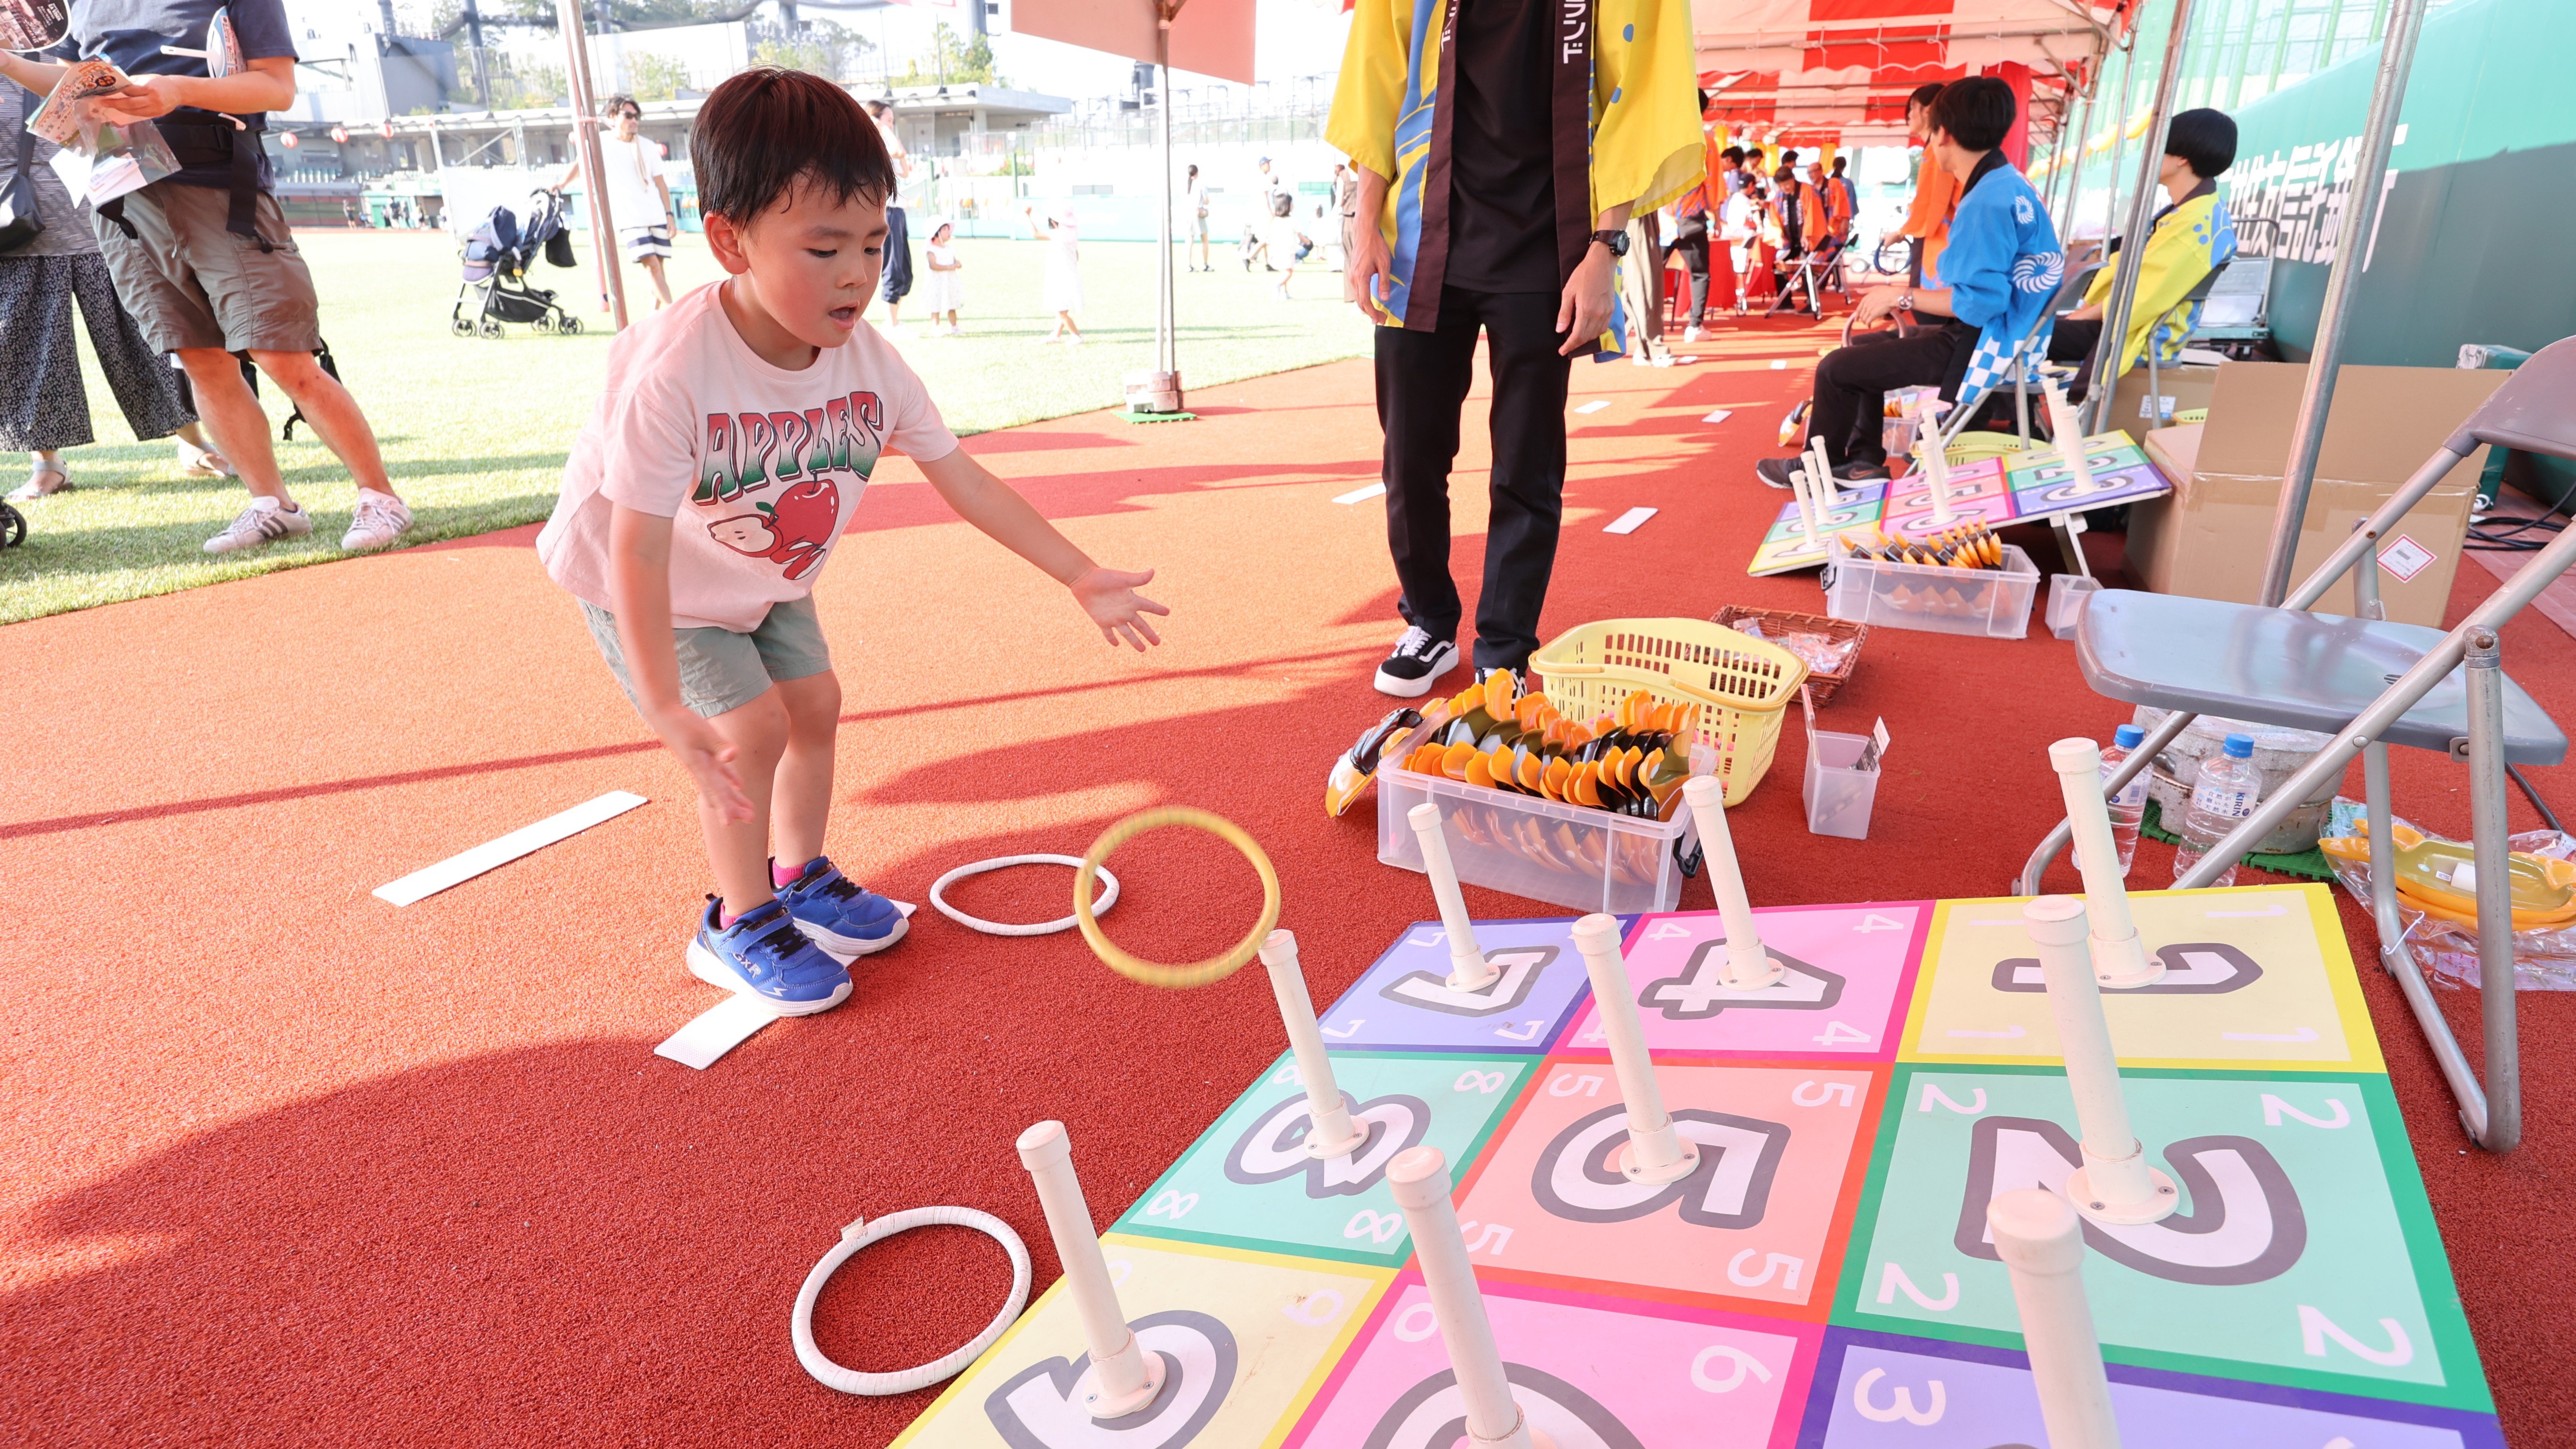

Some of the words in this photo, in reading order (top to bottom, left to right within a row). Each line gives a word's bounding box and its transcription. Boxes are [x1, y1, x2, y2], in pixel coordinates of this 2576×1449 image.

[691, 391, 883, 506] APPLES
[2205, 805, 2228, 814] 天然水
[2208, 791, 2231, 801] 自然が
[2232, 792, 2245, 816] KIRIN
[1852, 914, 1904, 933] 4
[2206, 904, 2287, 918] 1
[1406, 932, 1446, 947] 7
[1648, 923, 1691, 940] 4
[1379, 946, 1560, 1017] 7
[1638, 937, 1846, 1020] 4
[1320, 1020, 1365, 1038] 7
[1494, 1021, 1545, 1040] 7
[1812, 1021, 1871, 1046] 4
[1948, 1024, 2026, 1038] 1
[2222, 1027, 2320, 1042] 1
[1454, 1070, 1505, 1094] 8
[1548, 1073, 1604, 1097] 5
[1791, 1080, 1856, 1107] 5
[1919, 1084, 1988, 1114] 2
[2261, 1093, 2350, 1129] 2
[1224, 1088, 1431, 1199] 8
[1531, 1103, 1791, 1229] 5
[1147, 1190, 1199, 1220] 8
[1954, 1116, 2307, 1286] 2
[1344, 1209, 1402, 1243] 8
[1462, 1220, 1514, 1256] 5
[1728, 1248, 1804, 1289] 5
[1876, 1262, 1960, 1311] 2
[1281, 1288, 1344, 1326] 9
[2297, 1304, 2414, 1366] 2
[1690, 1345, 1772, 1393] 6
[1853, 1367, 1946, 1426] 3
